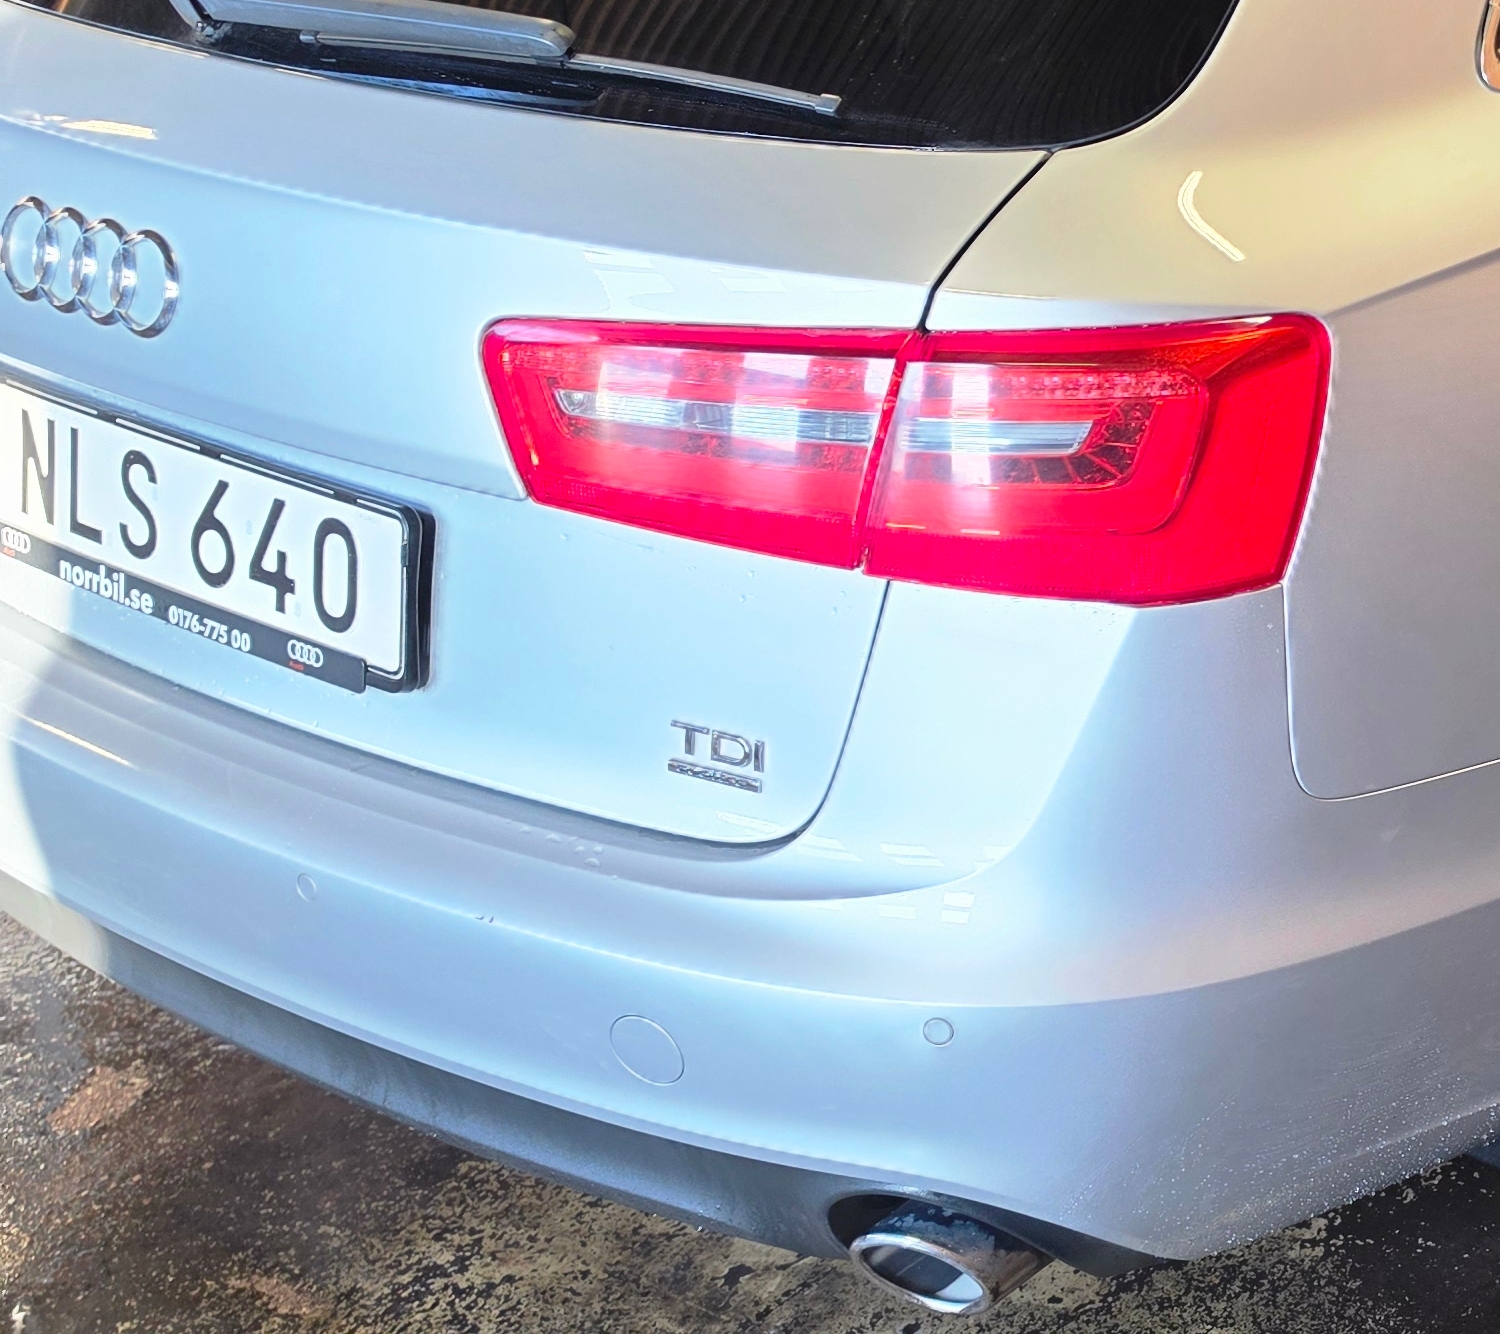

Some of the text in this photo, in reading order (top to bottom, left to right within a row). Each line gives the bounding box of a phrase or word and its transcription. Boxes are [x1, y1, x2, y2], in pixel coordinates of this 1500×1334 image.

[21, 408, 358, 634] NLS 640
[58, 559, 154, 615] norrbil.se
[168, 604, 251, 653] 0176-775 00
[670, 720, 765, 773] TDI
